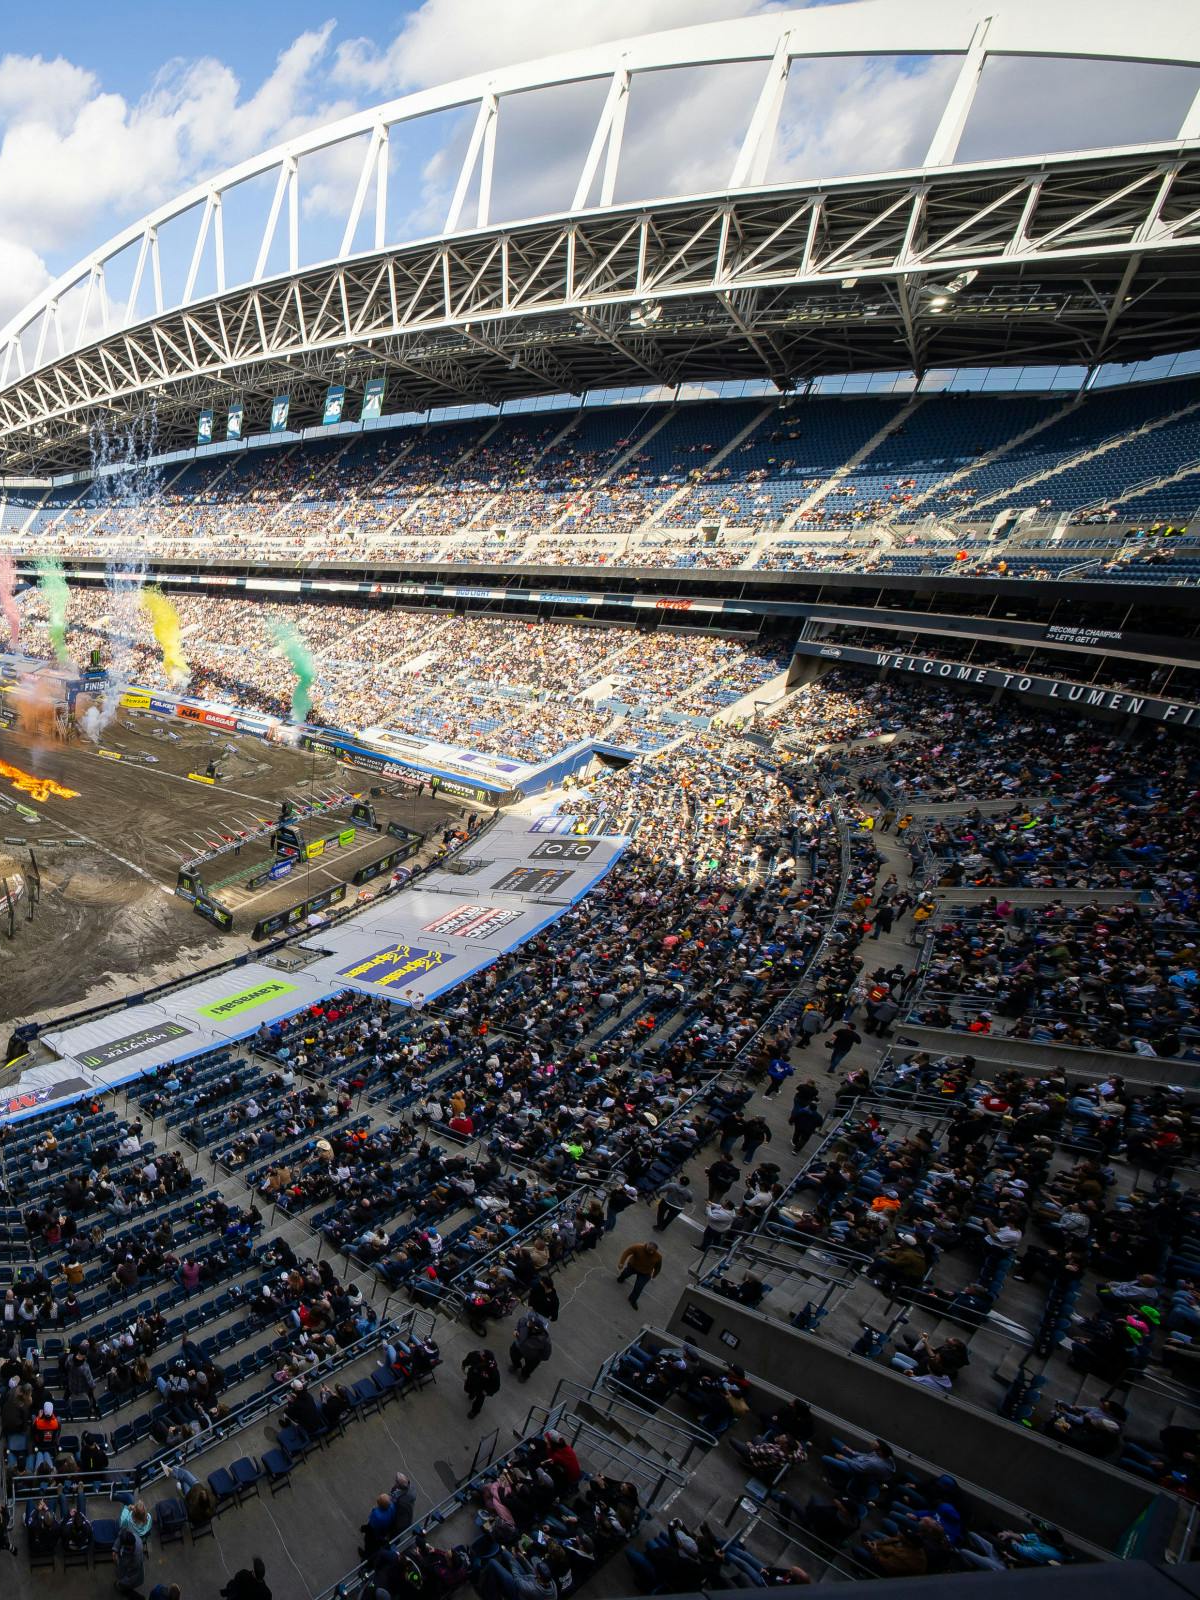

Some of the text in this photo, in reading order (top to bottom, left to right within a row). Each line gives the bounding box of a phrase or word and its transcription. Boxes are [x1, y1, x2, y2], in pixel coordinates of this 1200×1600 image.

[385, 585, 419, 594] DELTA
[1049, 625, 1079, 635] BECOME
[1055, 633, 1100, 645] LET'S GET IT
[85, 681, 110, 691] FINISH
[876, 653, 987, 683] WELCOME
[1003, 674, 1032, 691] TO
[1050, 683, 1145, 714] LUMEN
[180, 710, 200, 719] KTM
[206, 714, 235, 727] GASGAS
[311, 741, 335, 752] MONSTER
[354, 760, 382, 771] COMMISSION
[367, 758, 383, 766] SPORTS
[442, 780, 475, 796] MONSTER
[210, 984, 284, 1015] Kawasaki
[103, 1032, 168, 1059] MONSTER
